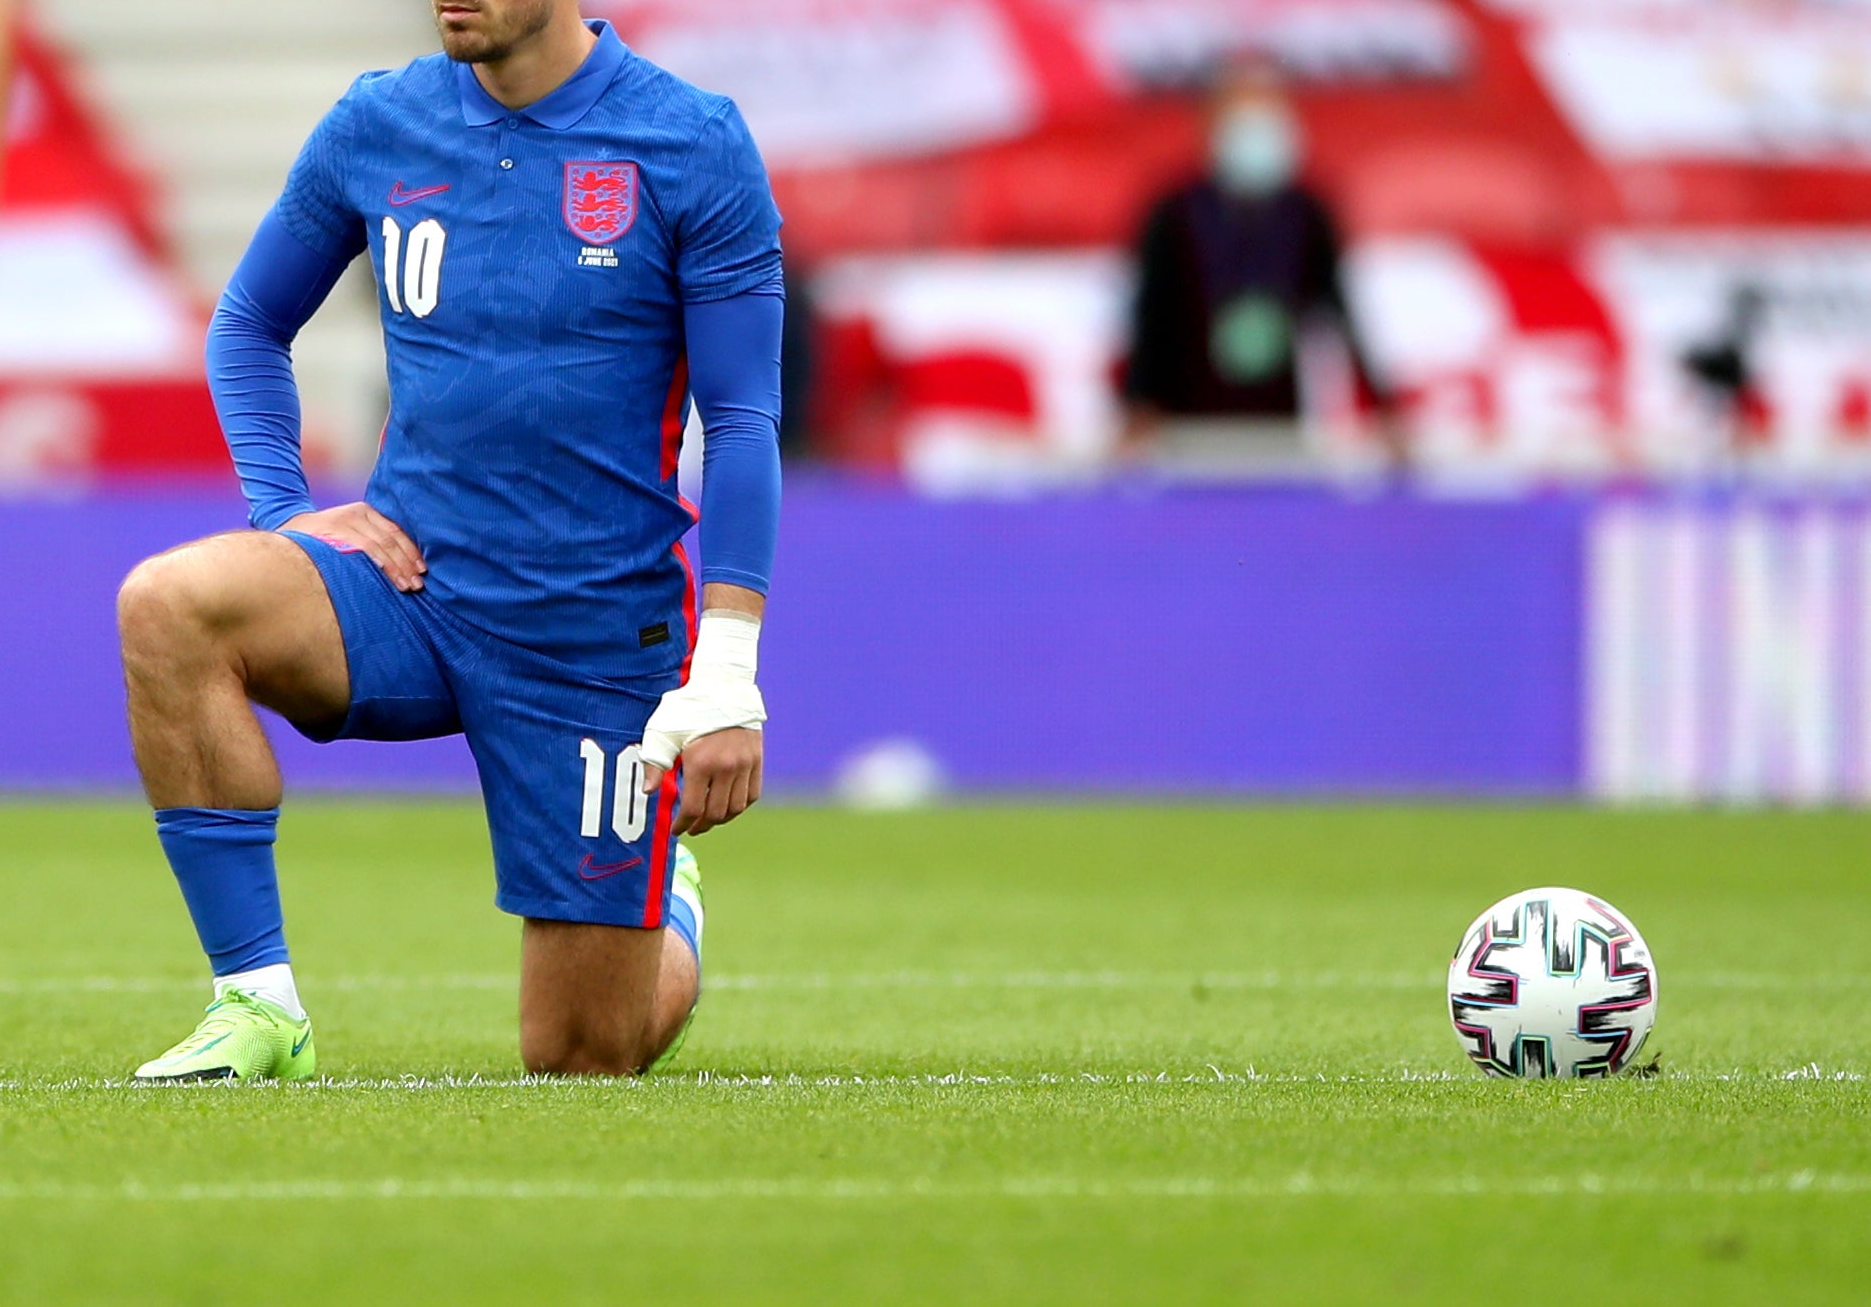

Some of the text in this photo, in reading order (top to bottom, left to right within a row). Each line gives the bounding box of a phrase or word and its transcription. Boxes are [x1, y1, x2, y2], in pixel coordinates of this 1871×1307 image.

[382, 216, 447, 318] 10
[581, 247, 614, 256] ROMANIA
[583, 257, 602, 267] JUNE
[579, 737, 649, 844] 10
